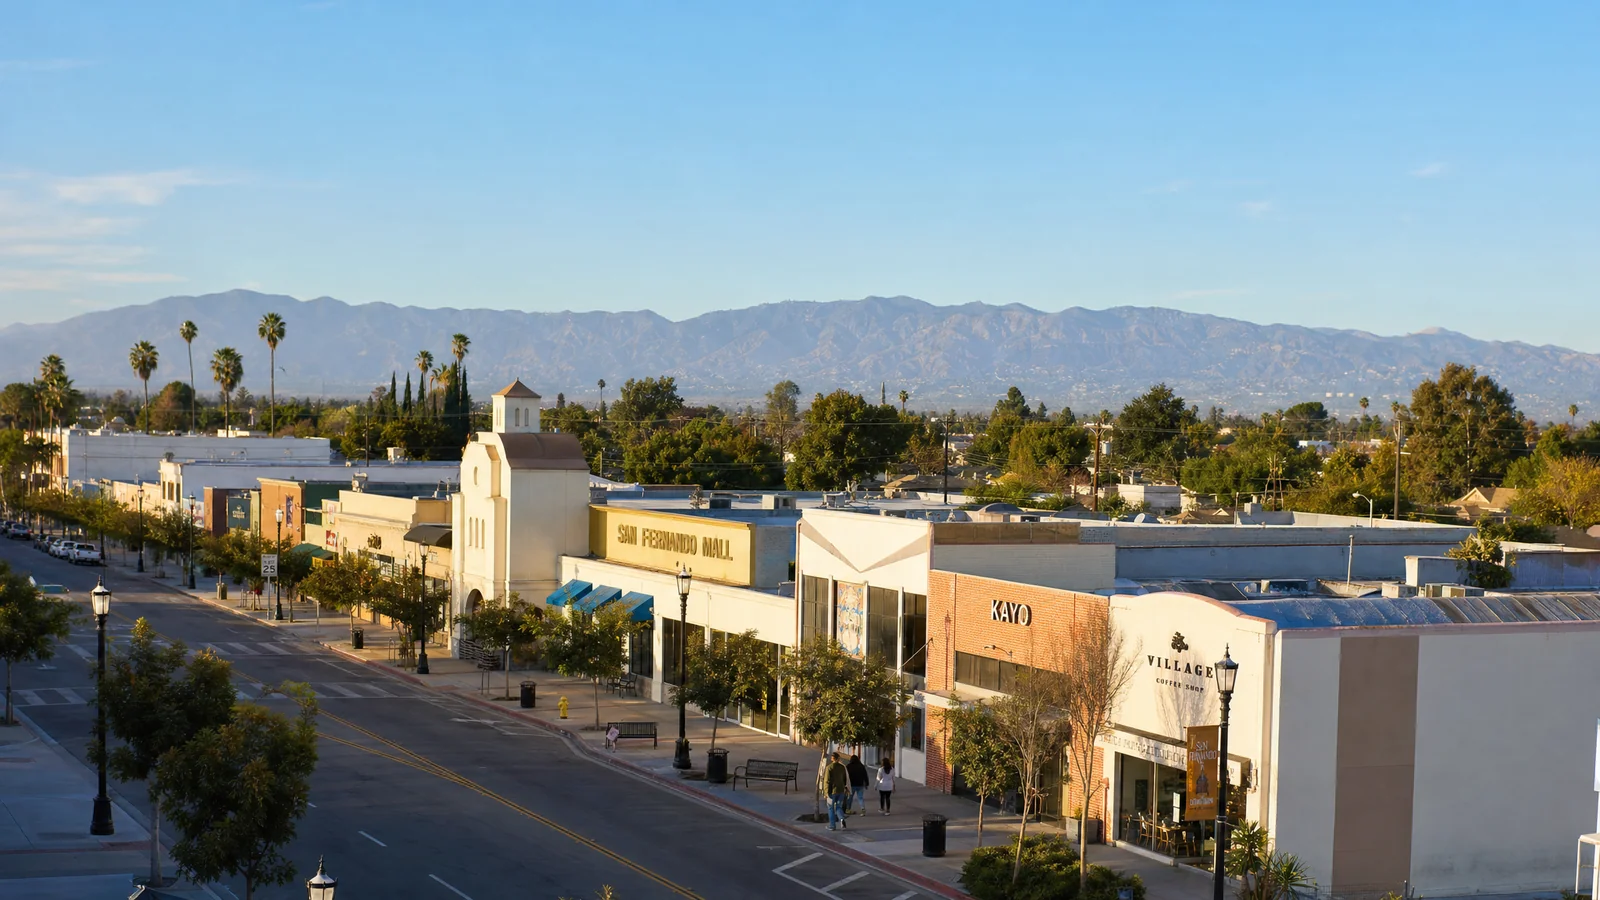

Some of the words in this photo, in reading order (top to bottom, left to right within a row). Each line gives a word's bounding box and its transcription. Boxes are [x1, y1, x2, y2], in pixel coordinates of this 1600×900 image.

[618, 523, 637, 545] SAN
[642, 528, 697, 556] FERNANDO
[702, 536, 733, 561] MALL
[263, 565, 276, 573] 25
[991, 599, 1032, 627] KAYO
[1147, 655, 1213, 678] VILLAGE
[1156, 677, 1181, 689] COFFEE
[1185, 684, 1204, 693] SHOP
